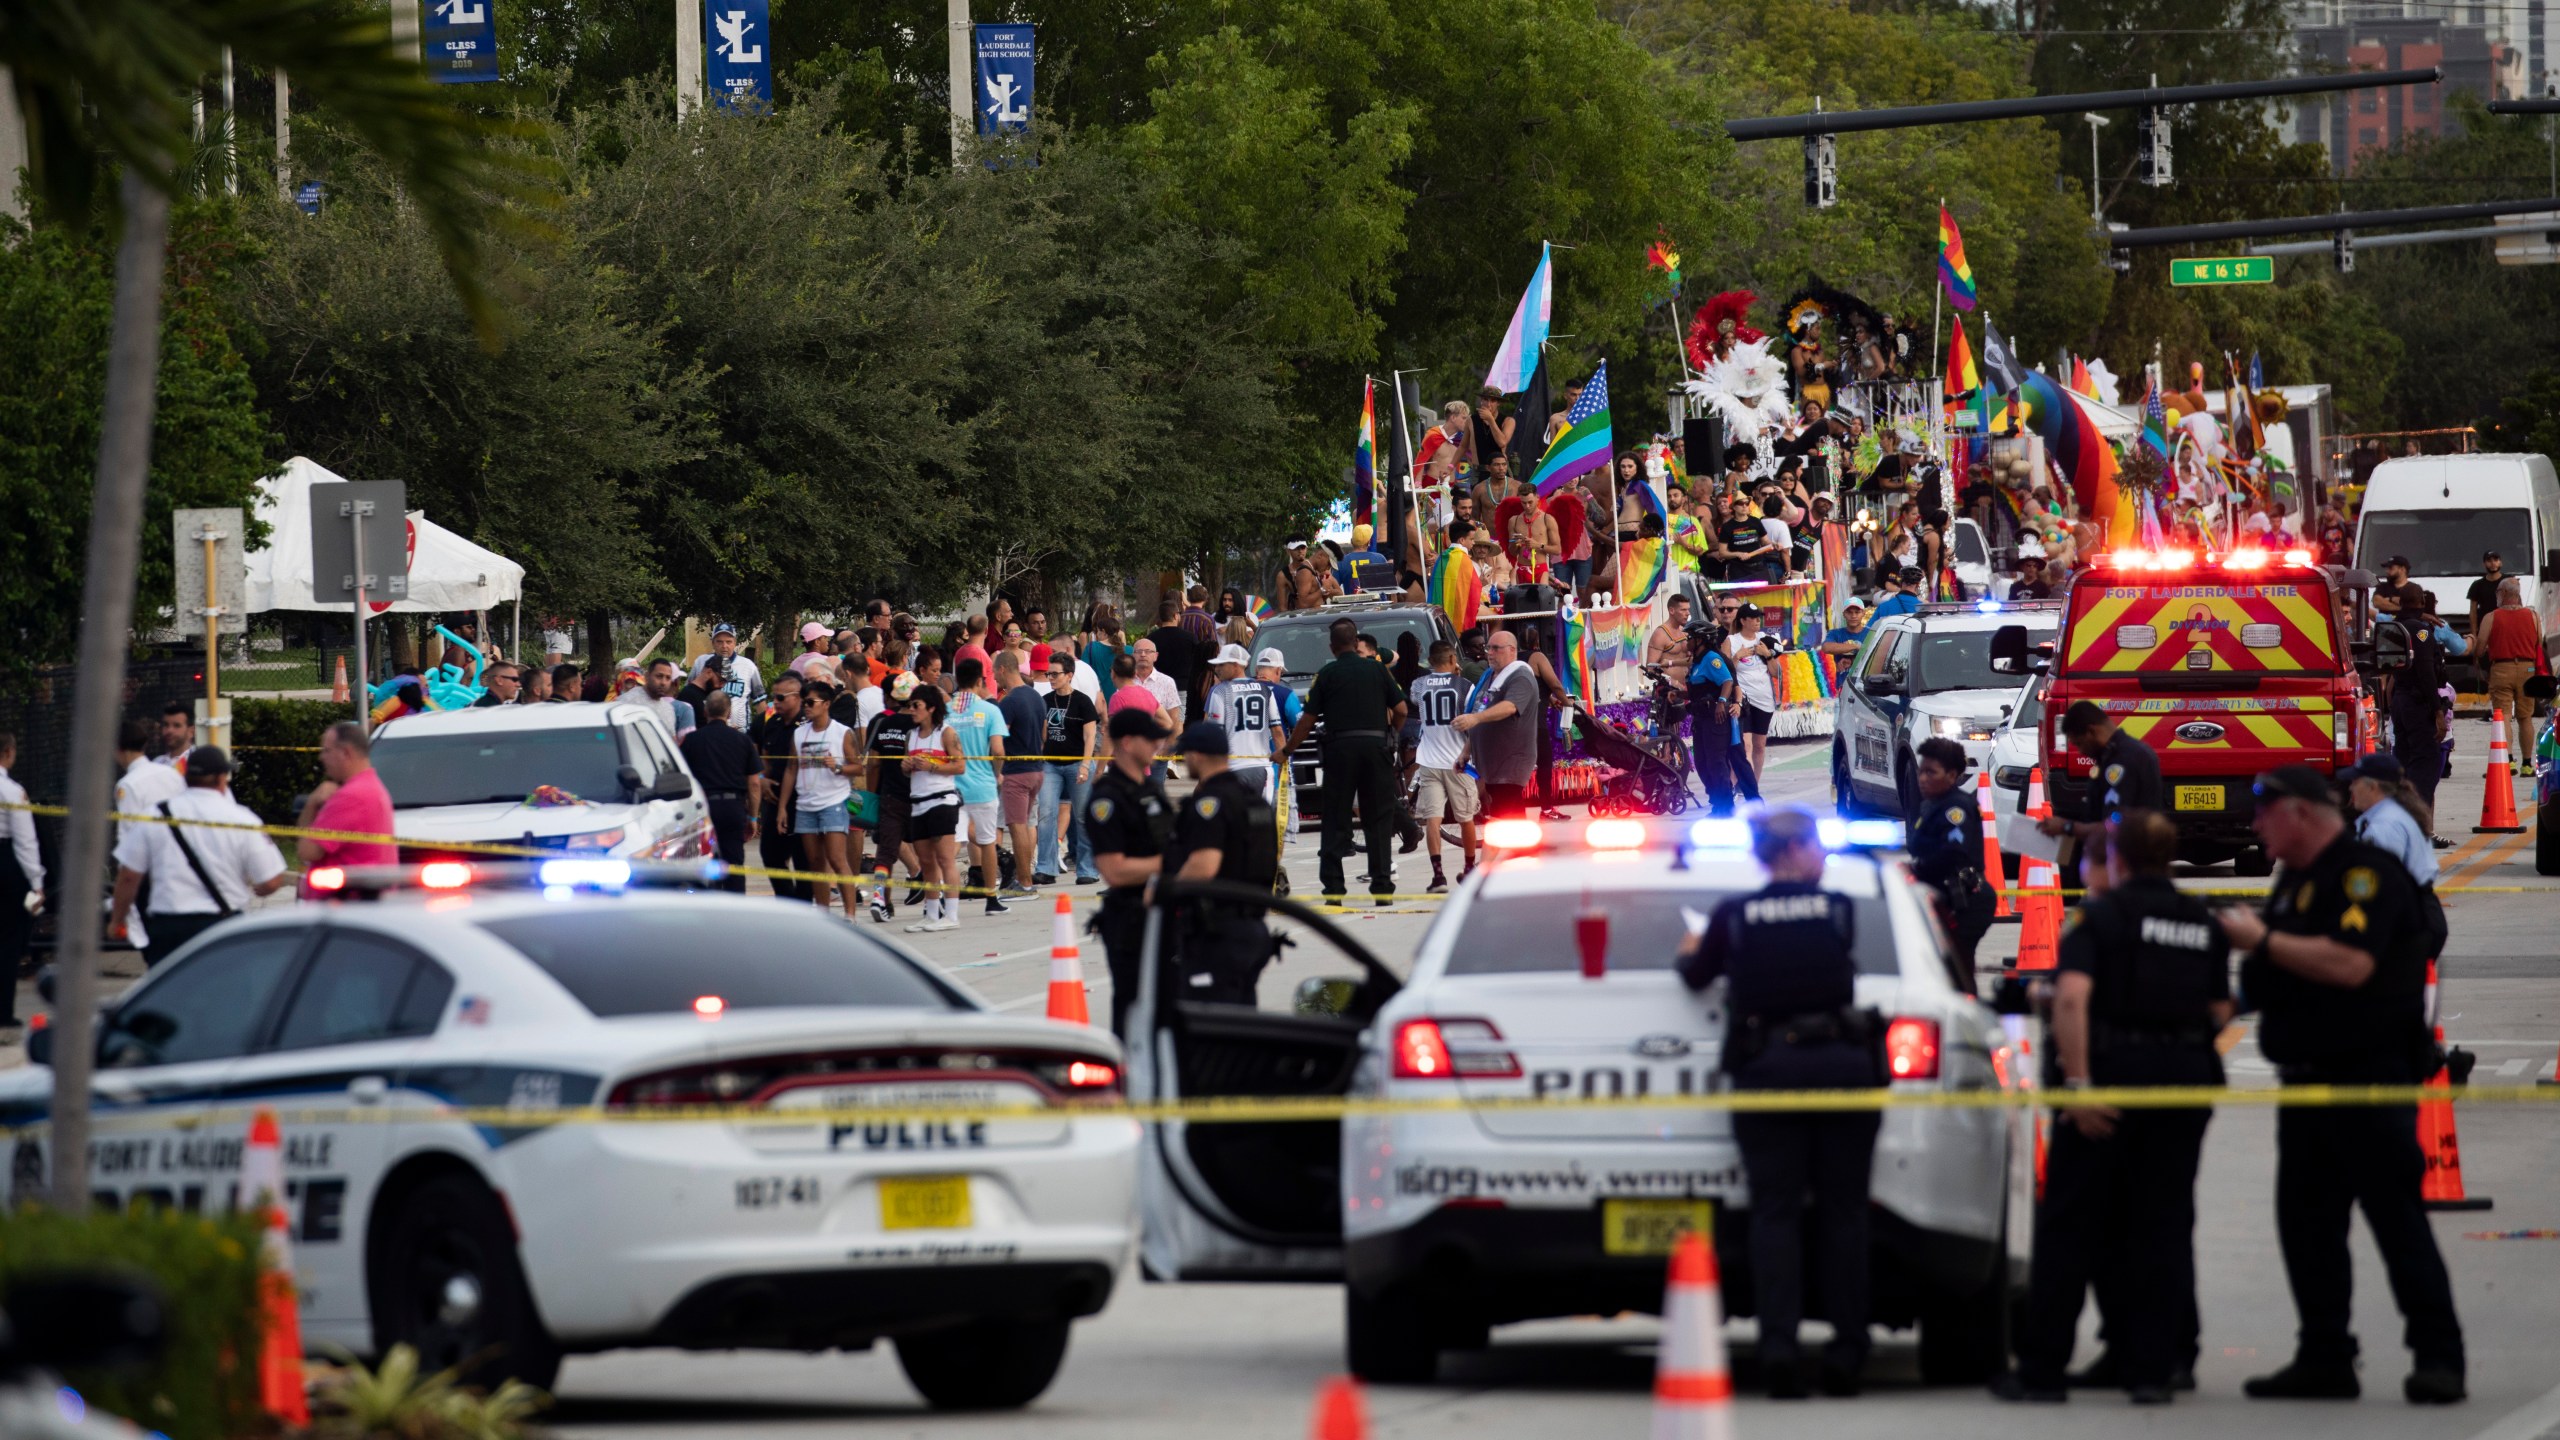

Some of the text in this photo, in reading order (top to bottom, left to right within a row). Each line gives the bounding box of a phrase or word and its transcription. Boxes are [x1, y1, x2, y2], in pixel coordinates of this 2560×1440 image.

[446, 41, 477, 50] CLASS
[979, 42, 1031, 50] LAUDERDALE
[455, 50, 468, 59] OF
[451, 60, 473, 69] 2019
[725, 78, 756, 87] CLASS
[2194, 262, 2249, 279] NE 16 ST
[2105, 585, 2298, 599] FORT LAUDERDALE FIRE
[2168, 619, 2231, 631] DIVISION
[2186, 603, 2212, 642] 2
[1232, 682, 1261, 693] ROSADO
[1426, 677, 1452, 686] CHAW
[1422, 688, 1458, 726] 10
[2098, 699, 2136, 711] SAVING
[2138, 699, 2162, 711] LIFE
[2164, 699, 2186, 711] AND
[2187, 699, 2242, 711] PROPERTY
[2244, 698, 2278, 710] SINCE
[1234, 694, 1266, 732] 19
[877, 732, 907, 741] BROWAR
[2186, 725, 2215, 739] Ford
[2183, 792, 2217, 805] XF6419
[1744, 894, 1829, 925] POLICE
[2141, 915, 2210, 951] POLICE
